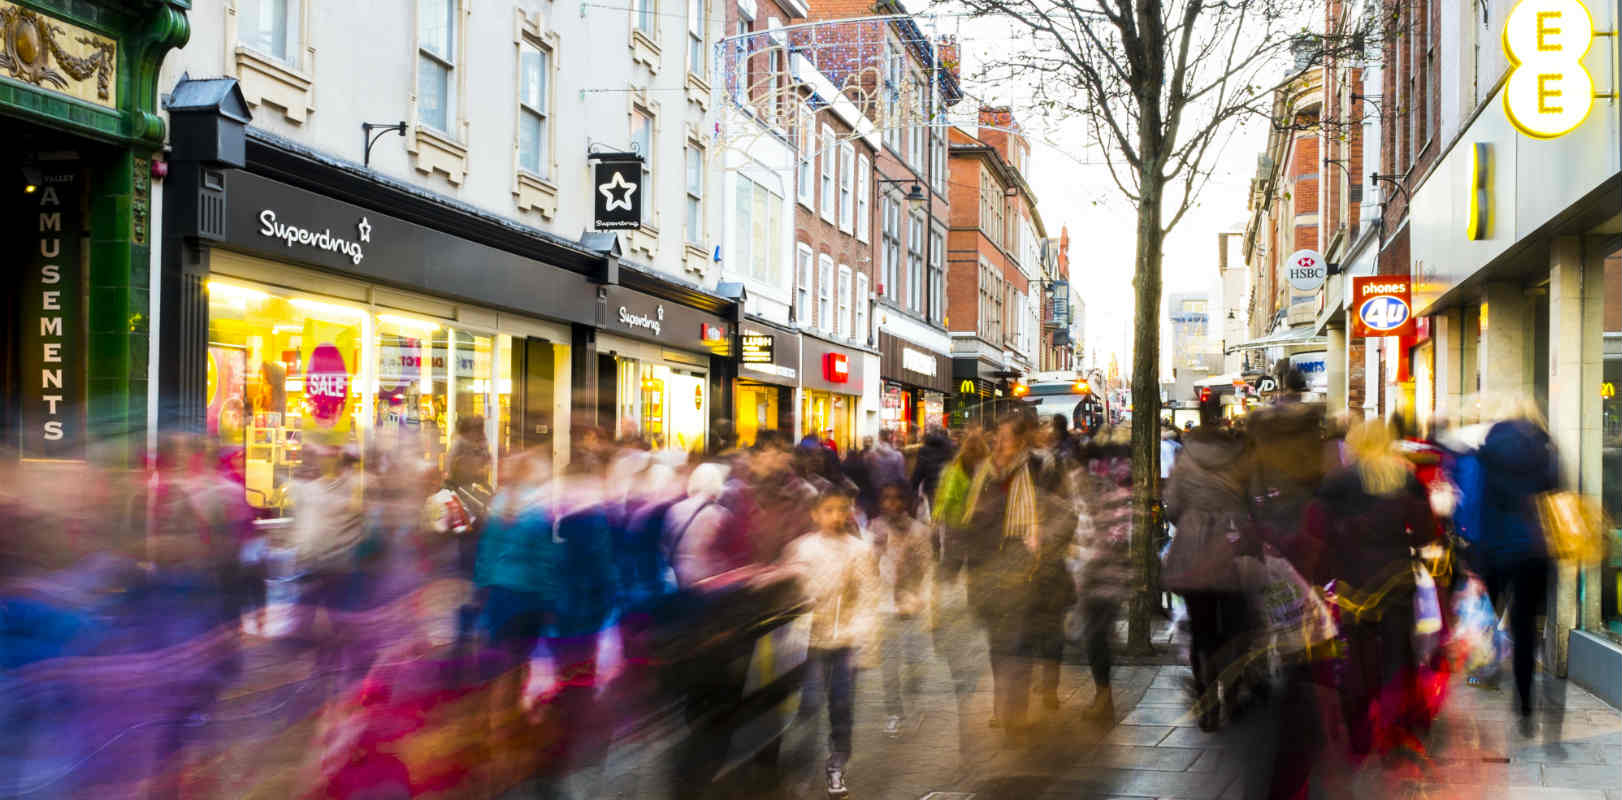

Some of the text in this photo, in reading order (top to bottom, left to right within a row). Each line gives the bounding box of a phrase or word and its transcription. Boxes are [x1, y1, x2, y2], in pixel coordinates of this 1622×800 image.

[595, 218, 640, 228] Superdrug
[259, 209, 364, 265] Superdrug
[1290, 267, 1324, 279] HSBC
[1362, 282, 1406, 297] phones
[39, 185, 63, 442] AMUSEMENTS
[618, 306, 661, 336] Superdrug
[742, 336, 772, 346] LUSH
[310, 372, 345, 397] SALE
[1257, 378, 1275, 393] JD
